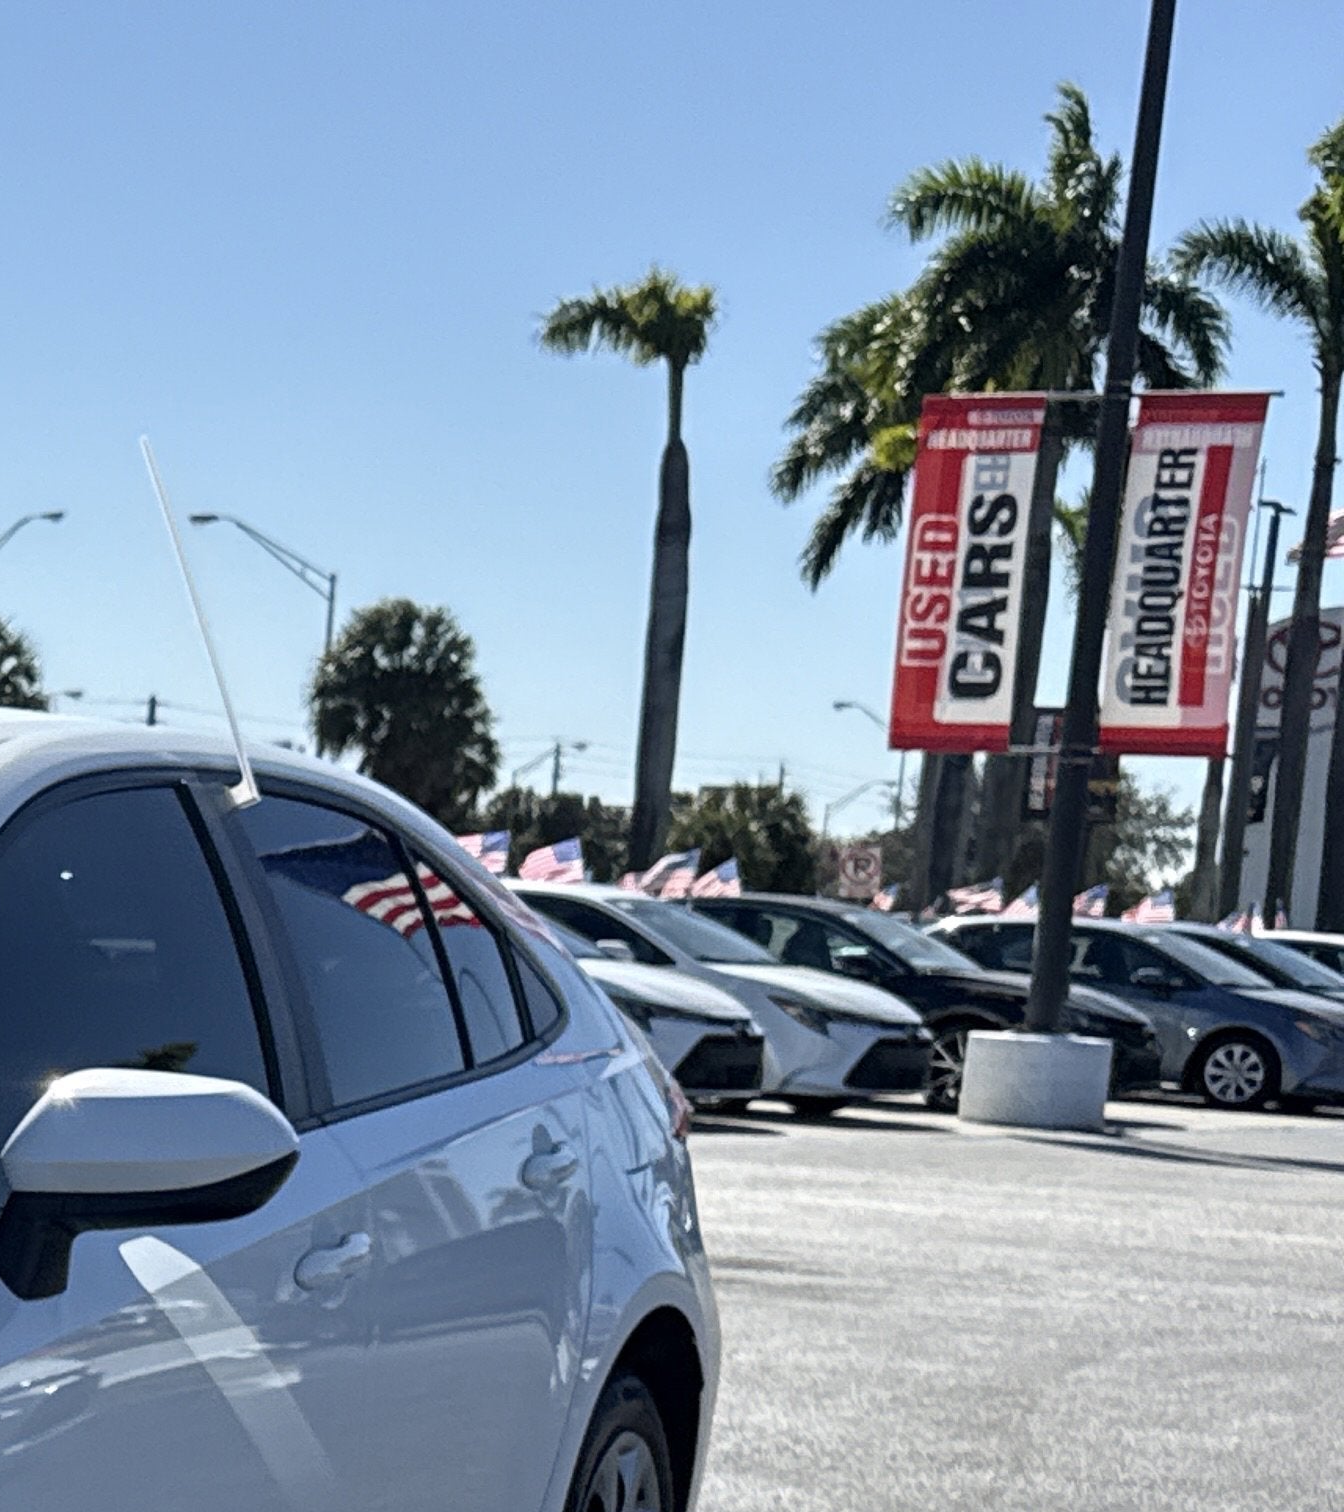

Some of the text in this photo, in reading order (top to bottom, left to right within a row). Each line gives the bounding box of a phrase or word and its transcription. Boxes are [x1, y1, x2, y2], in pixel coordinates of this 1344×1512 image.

[902, 513, 959, 667] USED
[948, 494, 1018, 698] CARS
[1129, 448, 1197, 706] HEADQUARTER
[1191, 513, 1219, 615] TOYOTA
